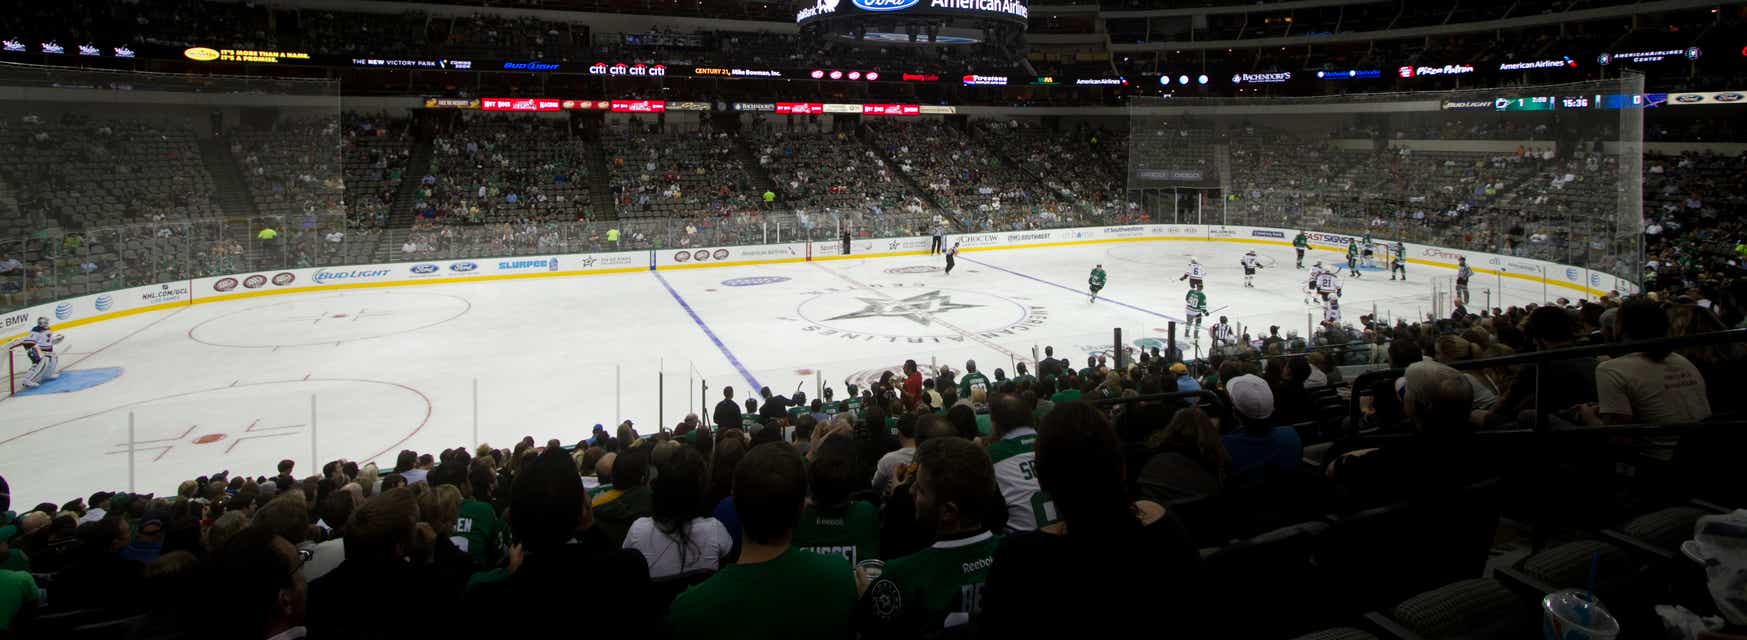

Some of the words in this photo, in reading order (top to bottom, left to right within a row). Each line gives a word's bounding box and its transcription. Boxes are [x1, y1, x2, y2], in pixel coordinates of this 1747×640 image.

[931, 0, 1001, 12] American
[504, 63, 525, 71] BUD
[527, 63, 560, 72] LIGHT
[589, 64, 606, 74] citi
[610, 64, 626, 75] citi
[629, 65, 646, 75] citi
[649, 65, 665, 76] citi
[1500, 62, 1535, 71] American
[1535, 60, 1564, 69] Airlines
[973, 74, 1008, 82] Firestone
[1562, 98, 1589, 108] 15:36
[498, 260, 547, 270] SLURPEE
[316, 270, 348, 280] BUD
[350, 269, 392, 279] LIGHT
[1193, 267, 1199, 275] 6
[1321, 278, 1331, 288] 21
[5, 313, 29, 327] BMW
[454, 518, 473, 533] EN
